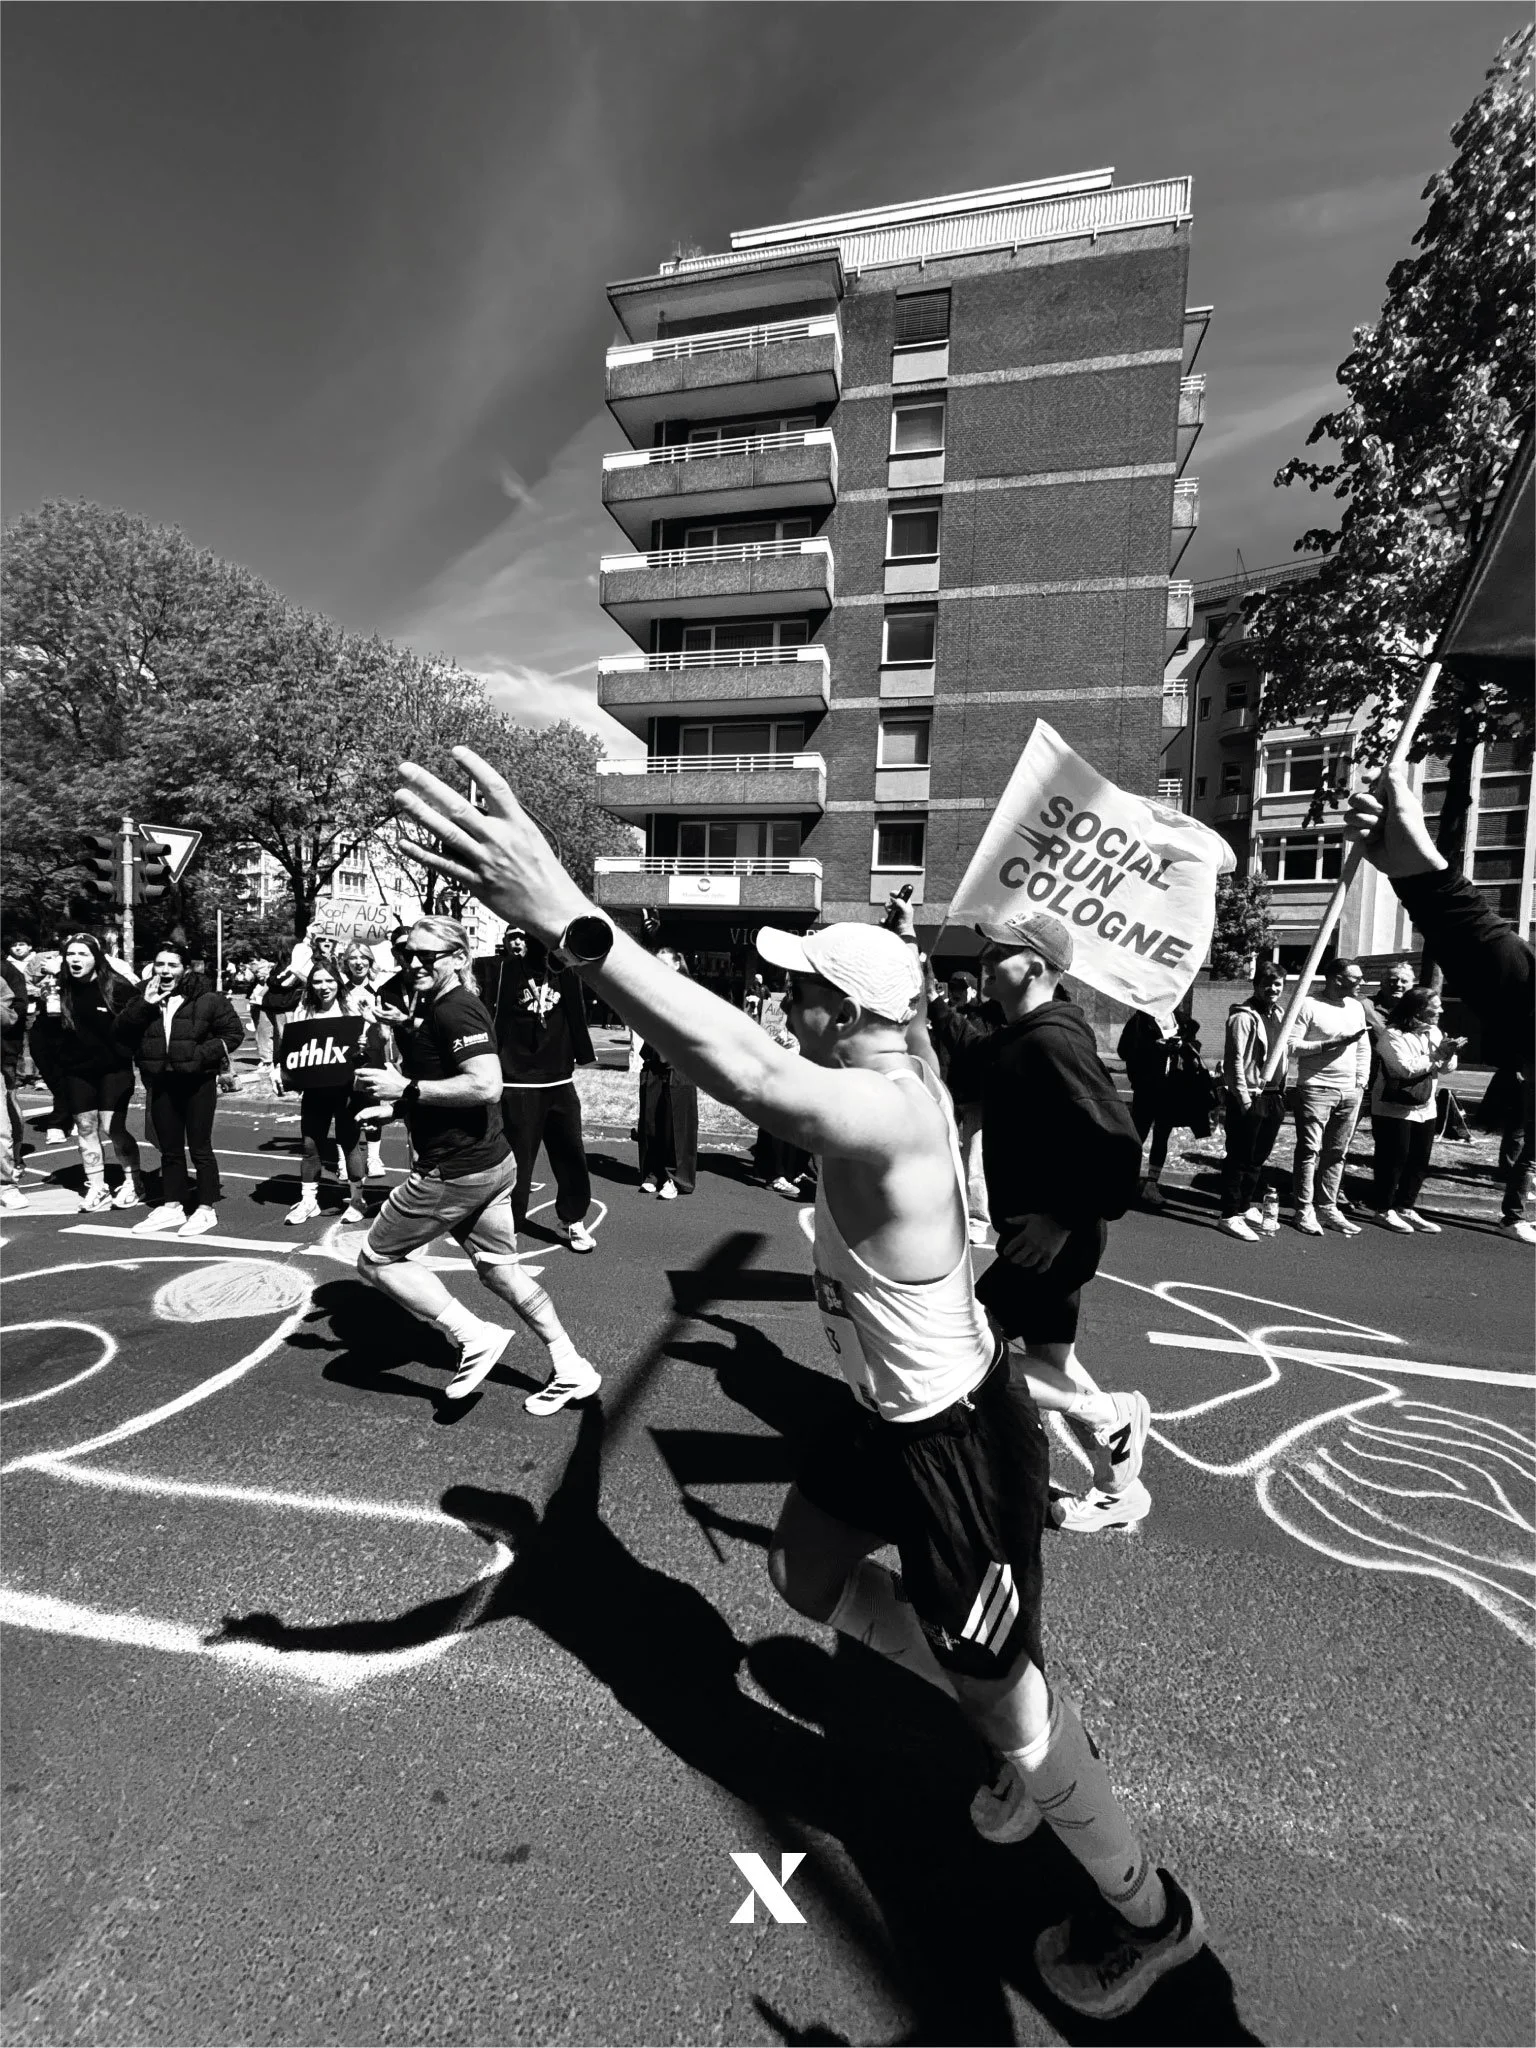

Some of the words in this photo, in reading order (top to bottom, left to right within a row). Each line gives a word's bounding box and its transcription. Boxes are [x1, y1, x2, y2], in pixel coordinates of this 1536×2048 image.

[1031, 833, 1125, 898] RUN
[1040, 796, 1173, 891] SOCIAL
[355, 905, 387, 924] AUS
[999, 857, 1193, 969] COLOGNE
[286, 1036, 350, 1070] athlx
